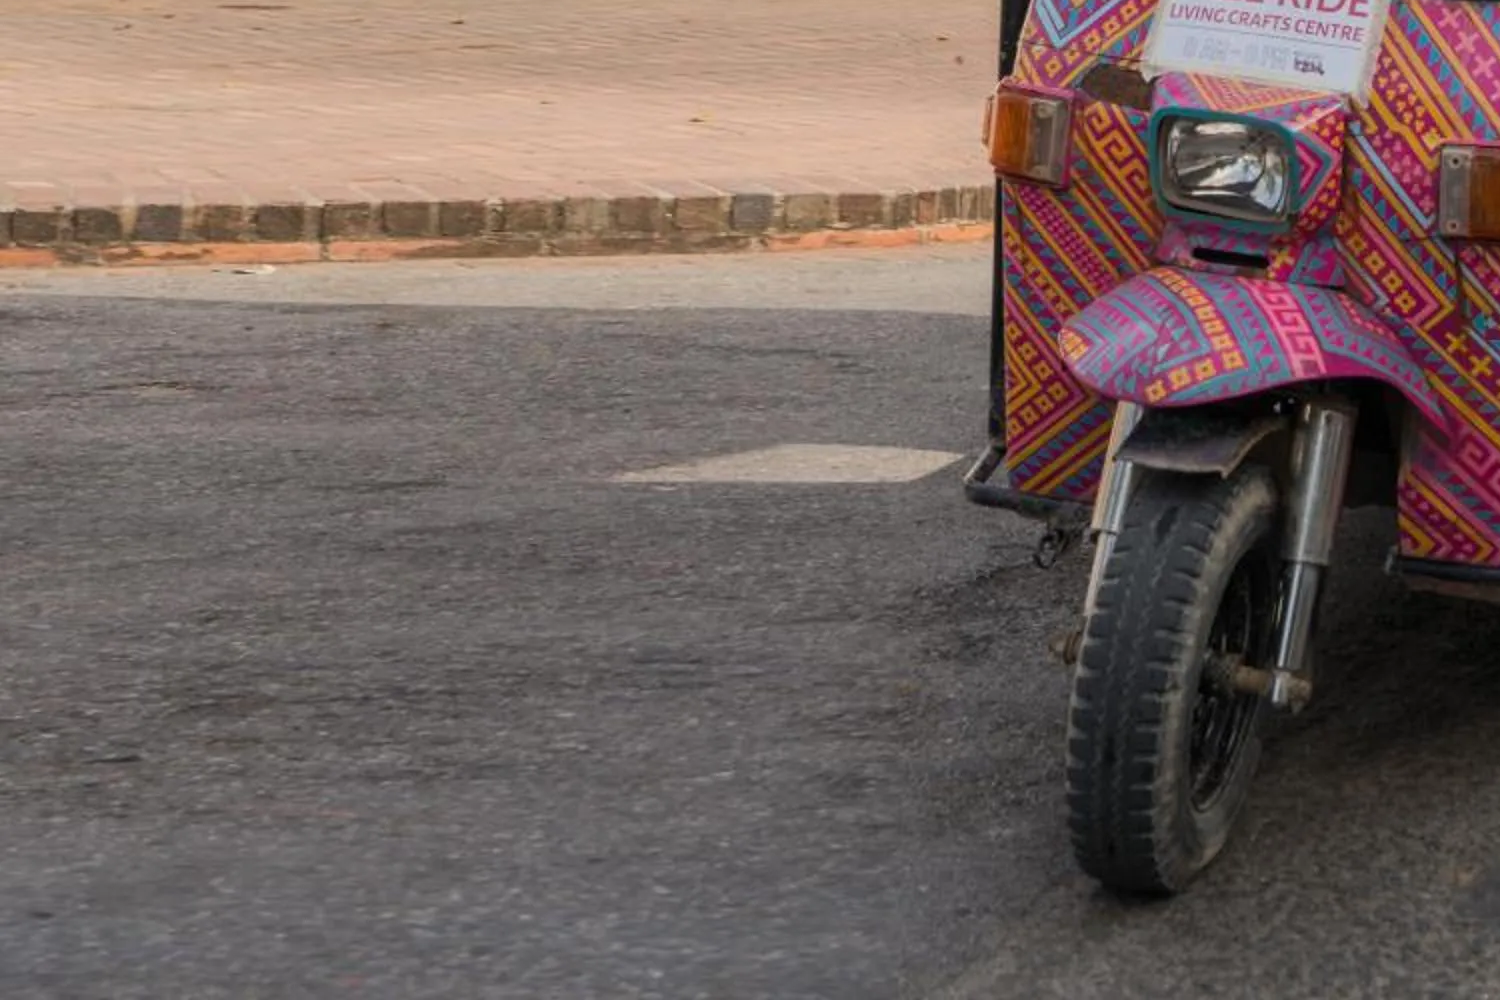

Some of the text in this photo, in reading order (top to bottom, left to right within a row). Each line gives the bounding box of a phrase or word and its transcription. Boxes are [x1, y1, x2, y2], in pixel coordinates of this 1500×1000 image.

[1170, 4, 1365, 42] LIVING CRAFTS CENTRE
